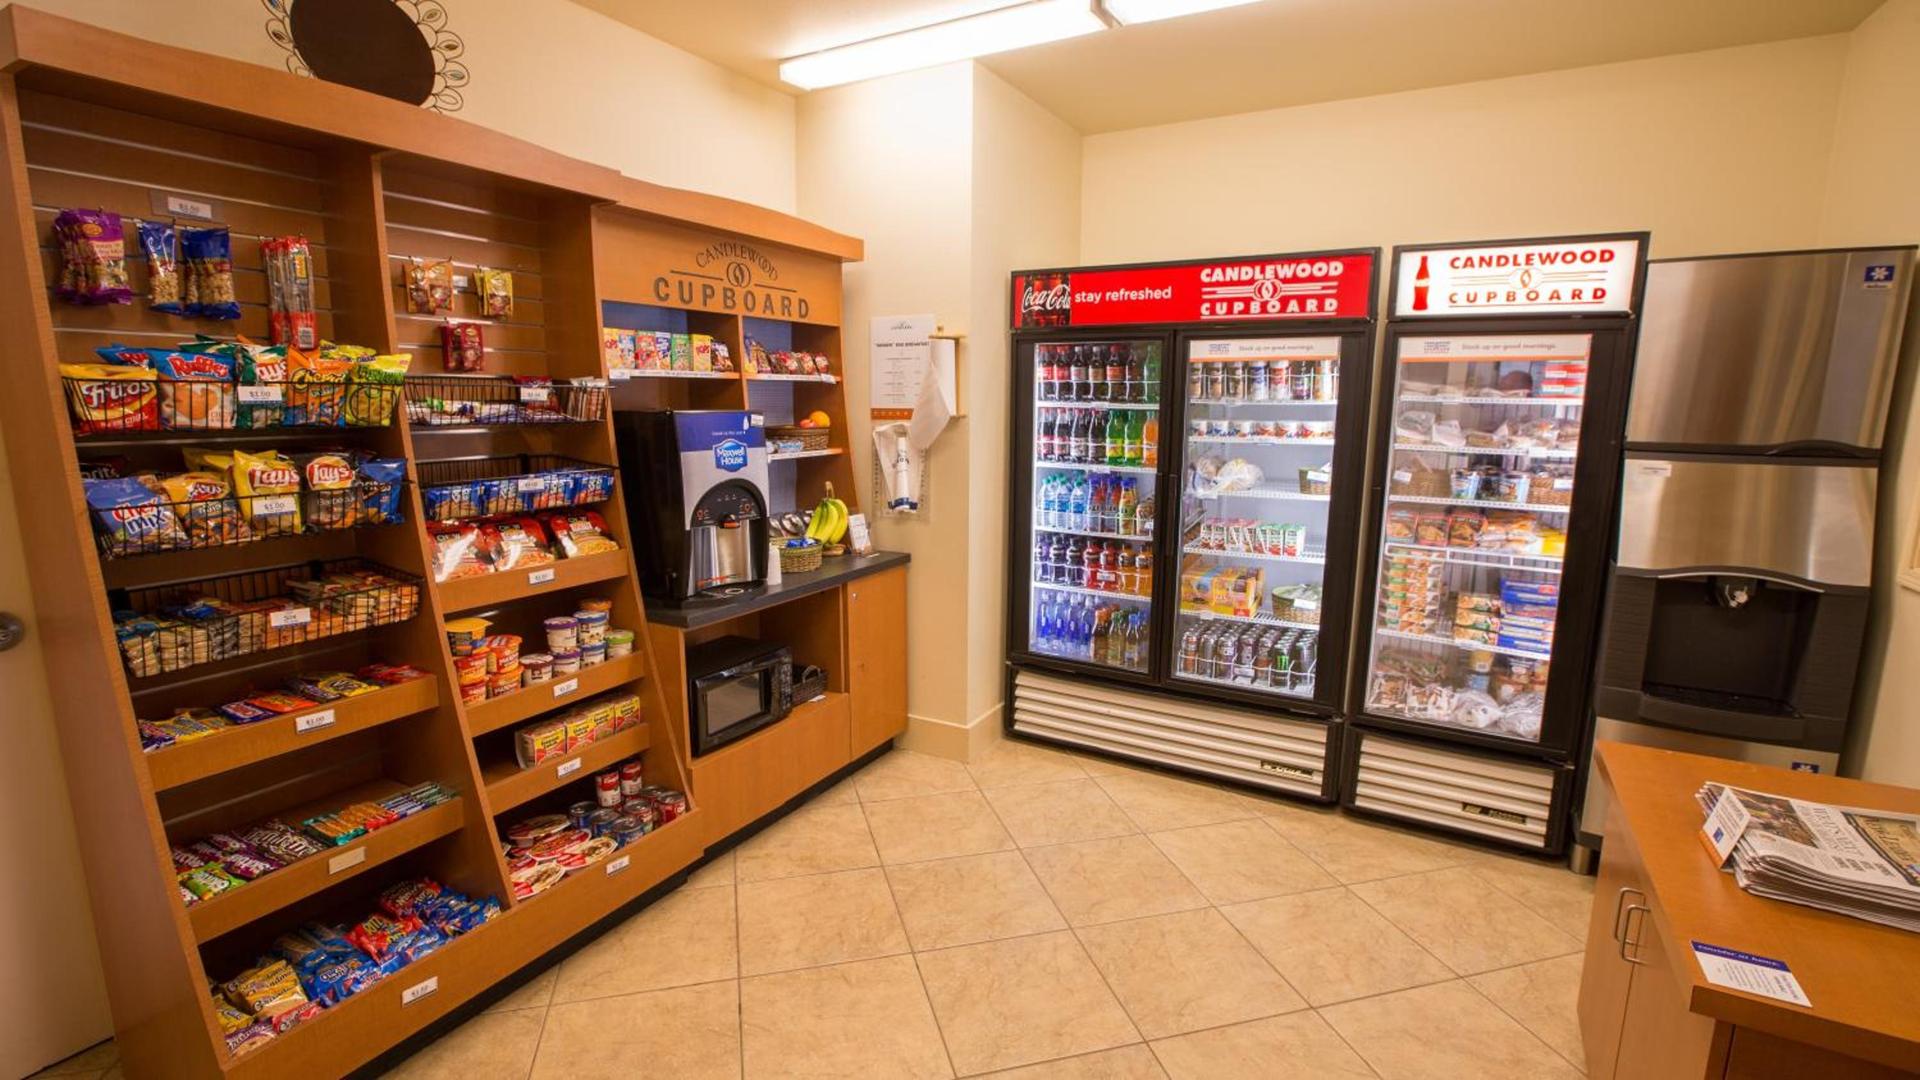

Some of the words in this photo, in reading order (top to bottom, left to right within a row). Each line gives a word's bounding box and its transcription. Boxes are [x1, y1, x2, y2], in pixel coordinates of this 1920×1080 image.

[696, 242, 779, 281] CANDLEWOOD
[1450, 249, 1615, 269] CANDLEWOOD
[1200, 261, 1344, 283] CANDLEWOOD
[653, 276, 810, 319] CUPBOARD
[1075, 291, 1101, 305] stay
[1105, 286, 1172, 302] refreshed
[1449, 288, 1606, 304] CUPBOARD
[1200, 298, 1338, 316] CUPBOARD
[82, 381, 151, 408] Fritos
[716, 446, 745, 459] Maxwell
[720, 456, 743, 466] House
